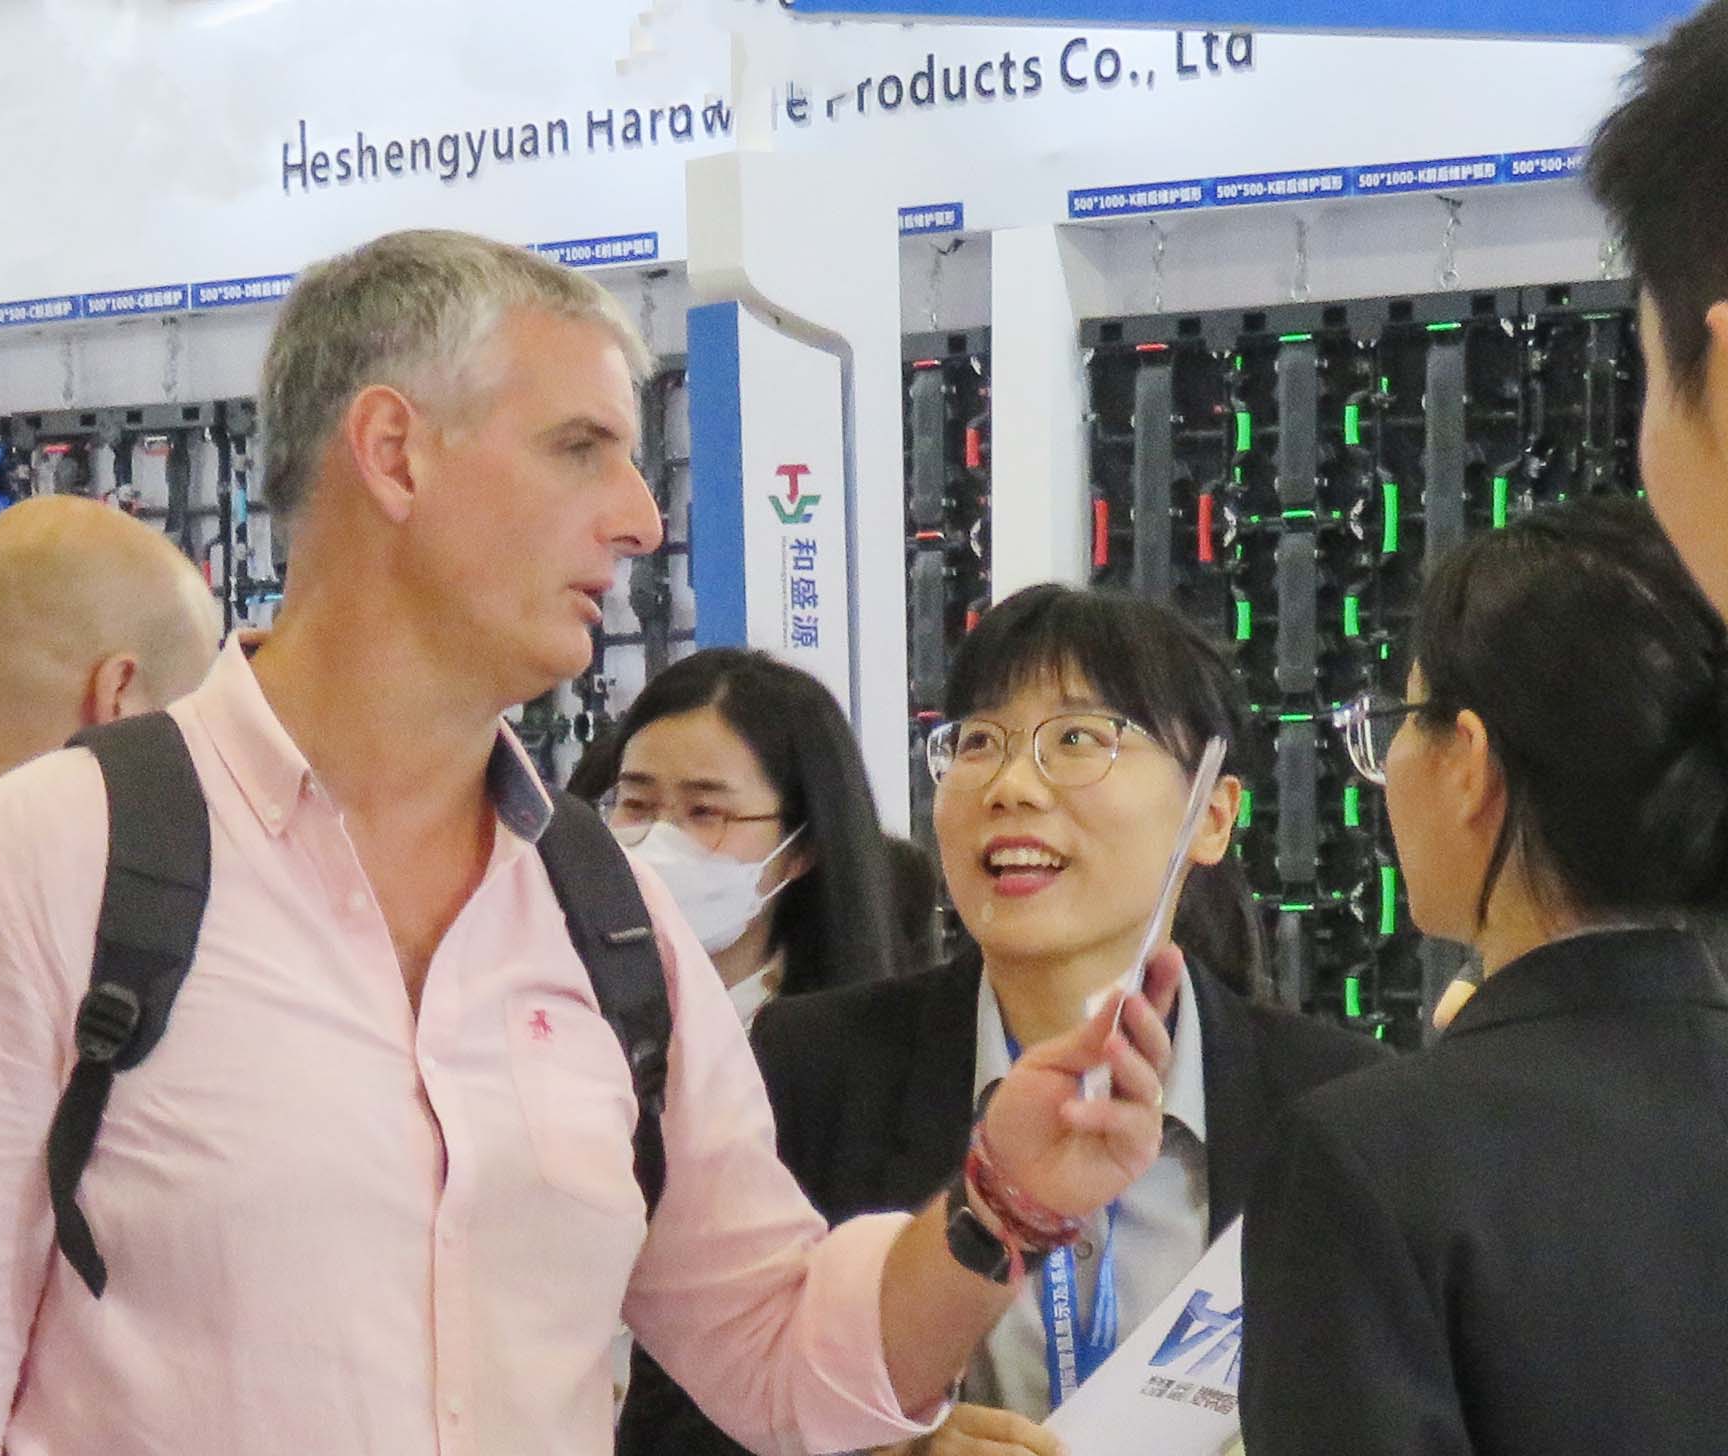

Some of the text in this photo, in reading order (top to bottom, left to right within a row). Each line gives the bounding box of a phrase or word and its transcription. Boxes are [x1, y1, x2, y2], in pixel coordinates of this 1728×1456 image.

[282, 118, 569, 190] Heshengyuan
[1060, 37, 1155, 90] Co.,
[789, 538, 819, 648] 和盛源
